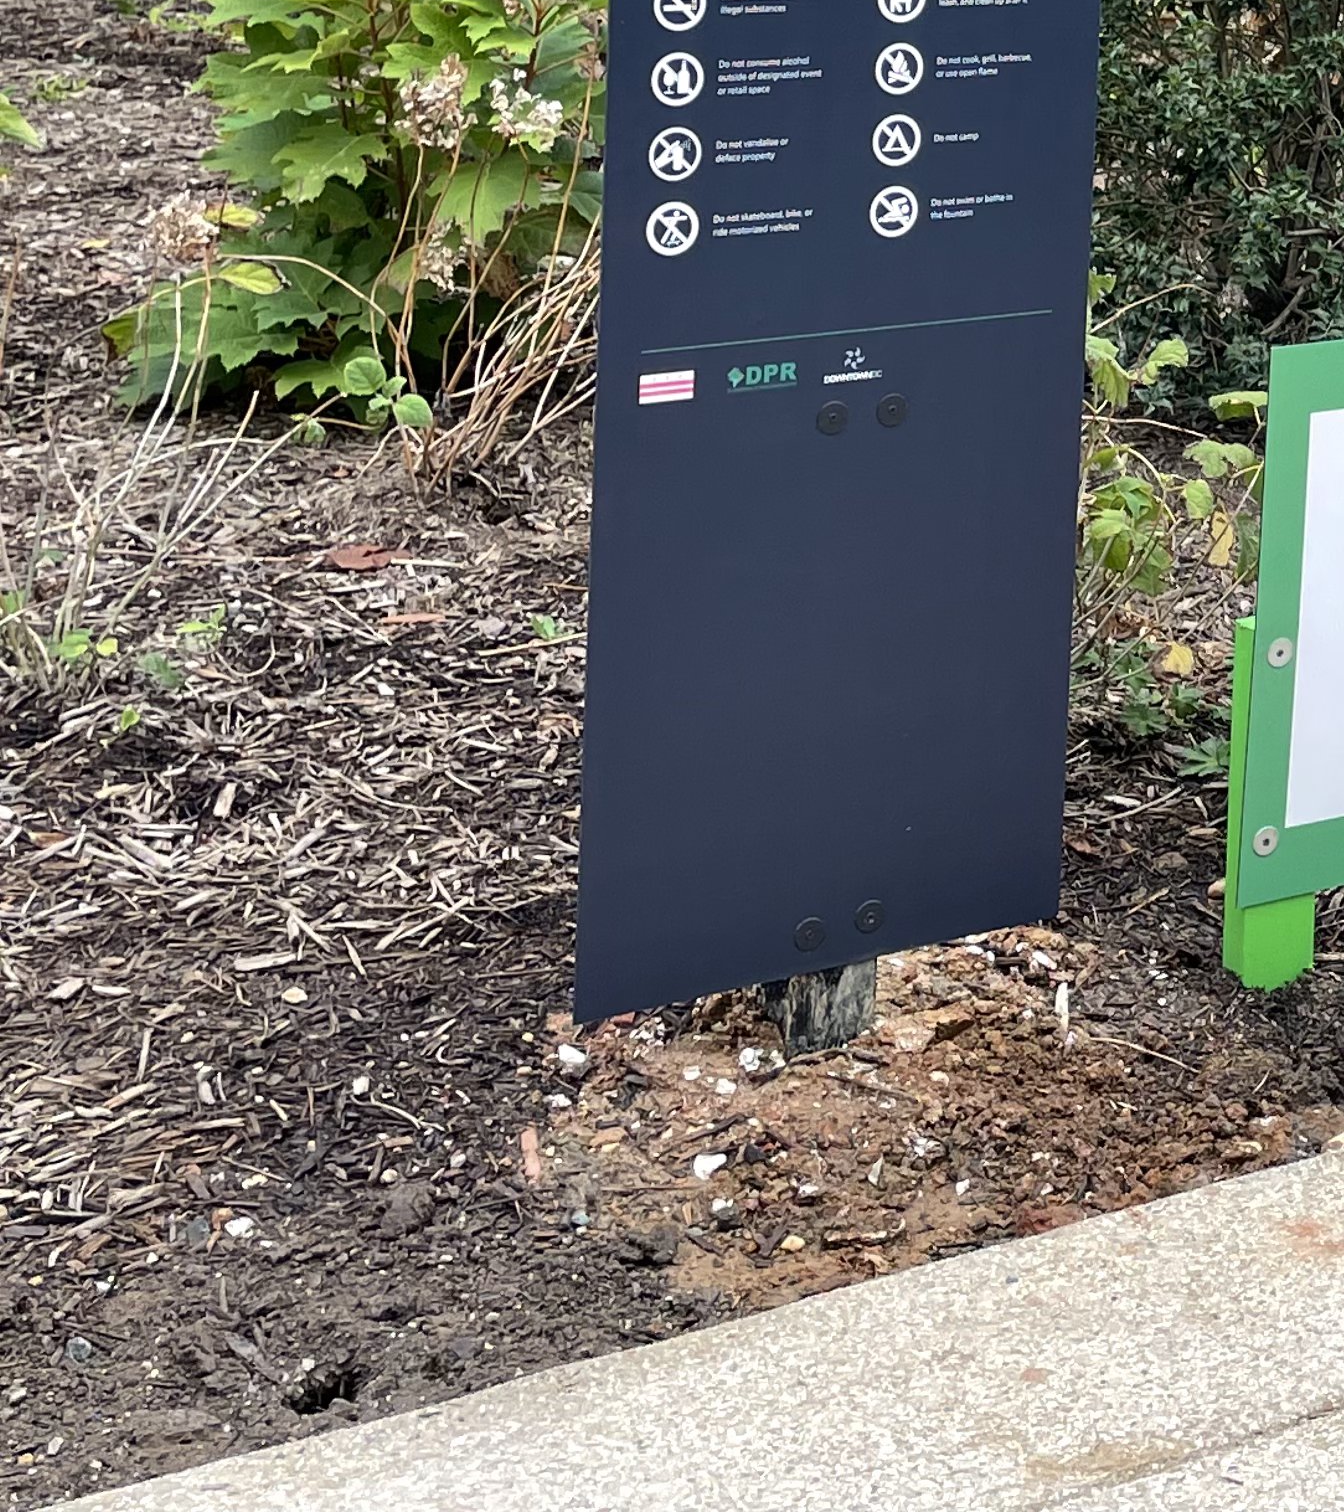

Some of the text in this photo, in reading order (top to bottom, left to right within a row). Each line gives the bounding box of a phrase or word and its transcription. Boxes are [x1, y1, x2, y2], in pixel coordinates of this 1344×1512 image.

[720, 5, 787, 16] illegal substances
[718, 56, 810, 69] Do not consume alcohol
[936, 56, 948, 66] Do
[949, 56, 960, 64] not
[717, 69, 822, 83] outside of designated event
[945, 70, 958, 78] use
[959, 69, 977, 78] open
[979, 67, 998, 76] flame
[717, 86, 771, 95] or retail space
[933, 133, 980, 143] Do not camp
[716, 140, 727, 150] Do
[728, 140, 742, 149] not
[780, 138, 789, 146] or
[715, 152, 776, 163] deface property
[930, 198, 942, 207] Do
[943, 197, 955, 206] not
[956, 196, 975, 205] swim
[976, 196, 984, 204] or
[984, 194, 1005, 203] bathe
[712, 214, 725, 224] Do
[726, 214, 739, 222] not
[804, 209, 813, 217] or
[930, 209, 974, 220] the fountain
[712, 223, 800, 237] ride motorized vehicles
[746, 362, 797, 385] DPR
